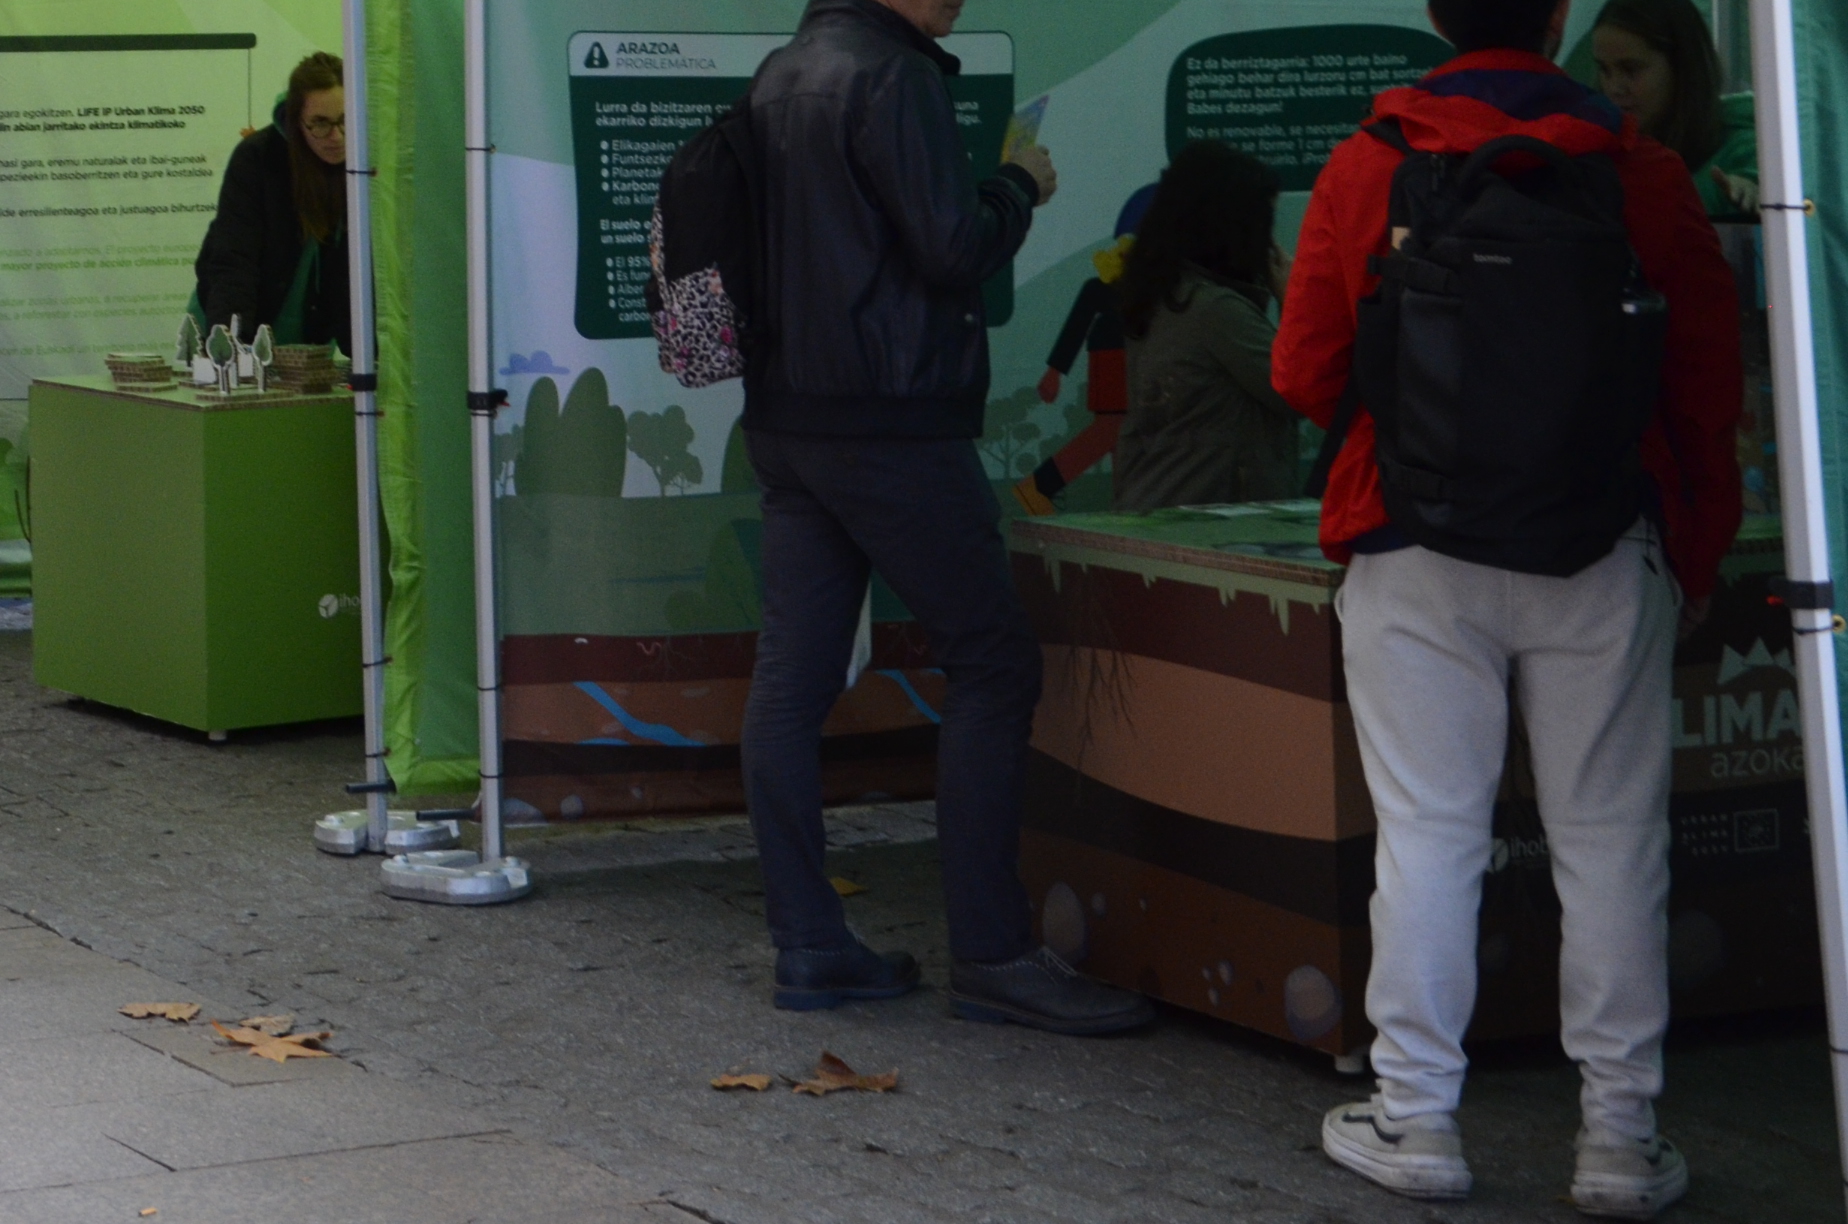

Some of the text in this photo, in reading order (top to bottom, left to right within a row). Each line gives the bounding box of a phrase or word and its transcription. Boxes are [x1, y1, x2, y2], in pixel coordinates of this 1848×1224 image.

[616, 42, 681, 55] ARAZOA
[1186, 57, 1201, 70] Ez
[1204, 56, 1219, 69] da
[1312, 54, 1344, 67] 1000
[1372, 53, 1409, 66] baino
[1369, 67, 1391, 80] bat
[76, 107, 100, 117] LIFE
[101, 107, 112, 117] IP
[114, 106, 145, 116] Urban
[147, 105, 176, 116] Klima
[178, 104, 206, 115] 2050
[594, 101, 629, 114] Lurra
[630, 101, 648, 114] da
[649, 101, 708, 114] bizitzaren
[1186, 102, 1223, 115] Babes
[12, 121, 41, 132] abian
[594, 114, 646, 126] ekarriko
[611, 138, 676, 154] Elikagaien
[130, 156, 148, 166] eta
[122, 170, 140, 179] eta
[611, 194, 631, 205] eta
[101, 206, 118, 216] eta
[611, 218, 641, 230] suelo
[1671, 687, 1802, 749] LIMA
